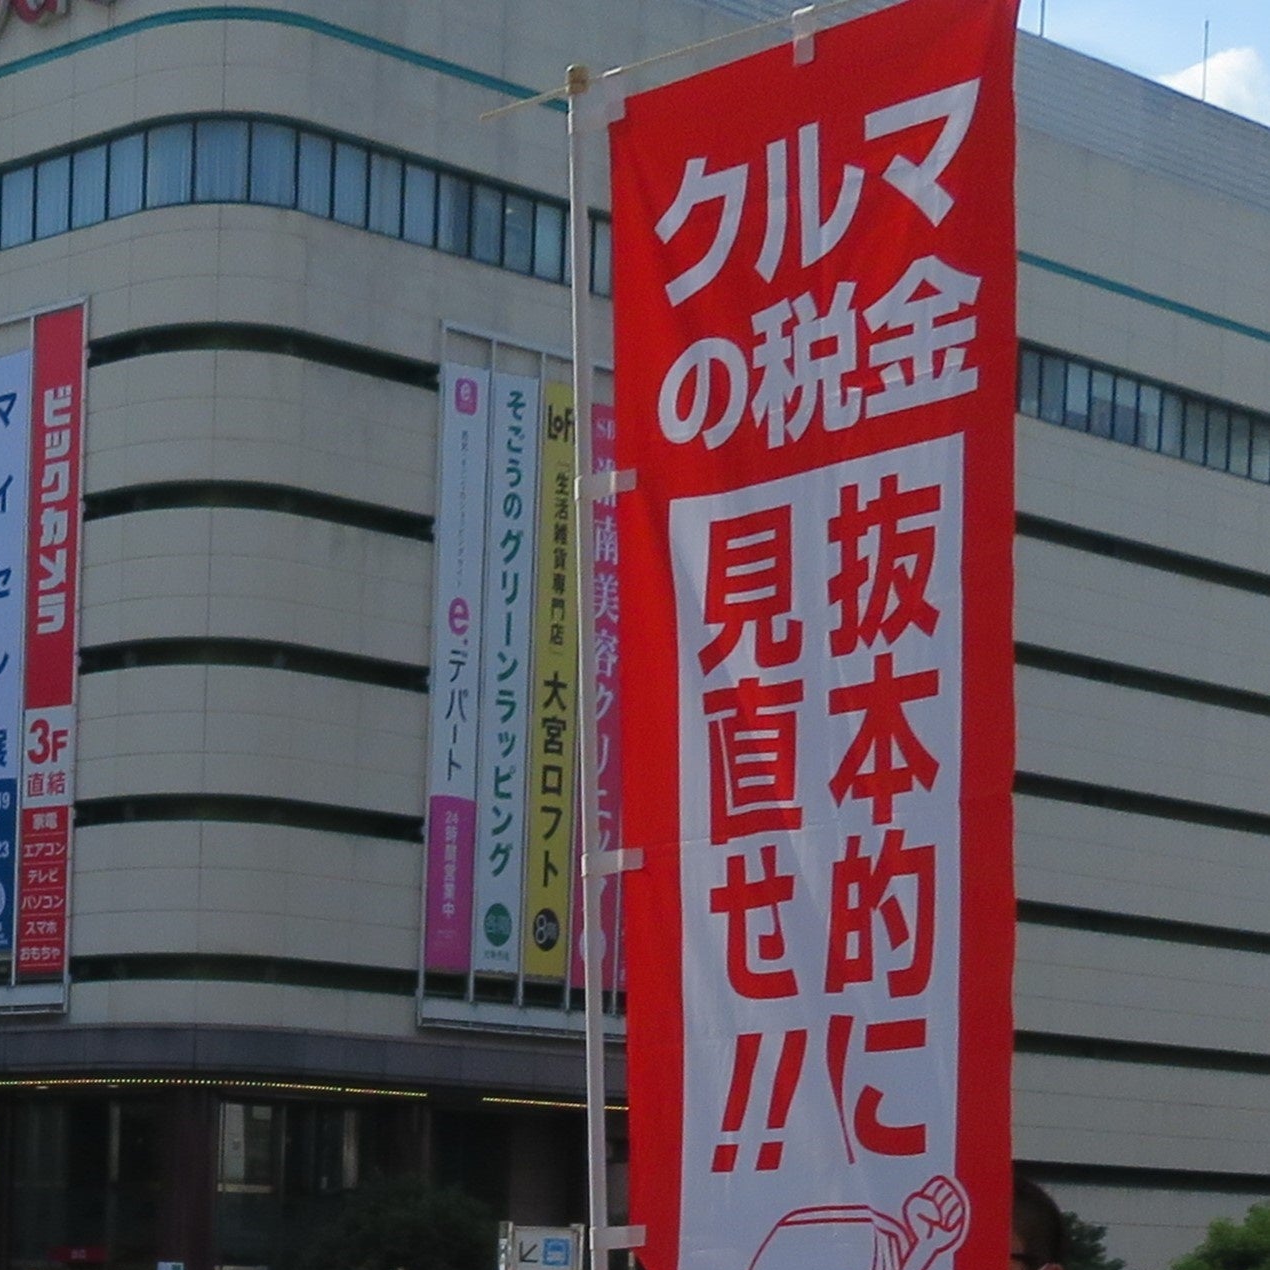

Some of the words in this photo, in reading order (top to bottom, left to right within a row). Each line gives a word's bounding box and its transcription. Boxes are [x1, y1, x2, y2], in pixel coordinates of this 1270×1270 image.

[655, 78, 981, 307] クルマ
[658, 255, 981, 450] の税金
[36, 384, 73, 635] ビックカメラ
[28, 718, 68, 764] 3F
[27, 771, 66, 797] 直結
[540, 671, 568, 888] 大宮ロフト
[824, 475, 941, 1165] 抜本的に
[23, 842, 66, 859] エアコン
[27, 868, 59, 884] テレビ
[21, 895, 65, 911] パソコン
[25, 920, 58, 936] スマホ
[20, 945, 61, 962] おもちゃ
